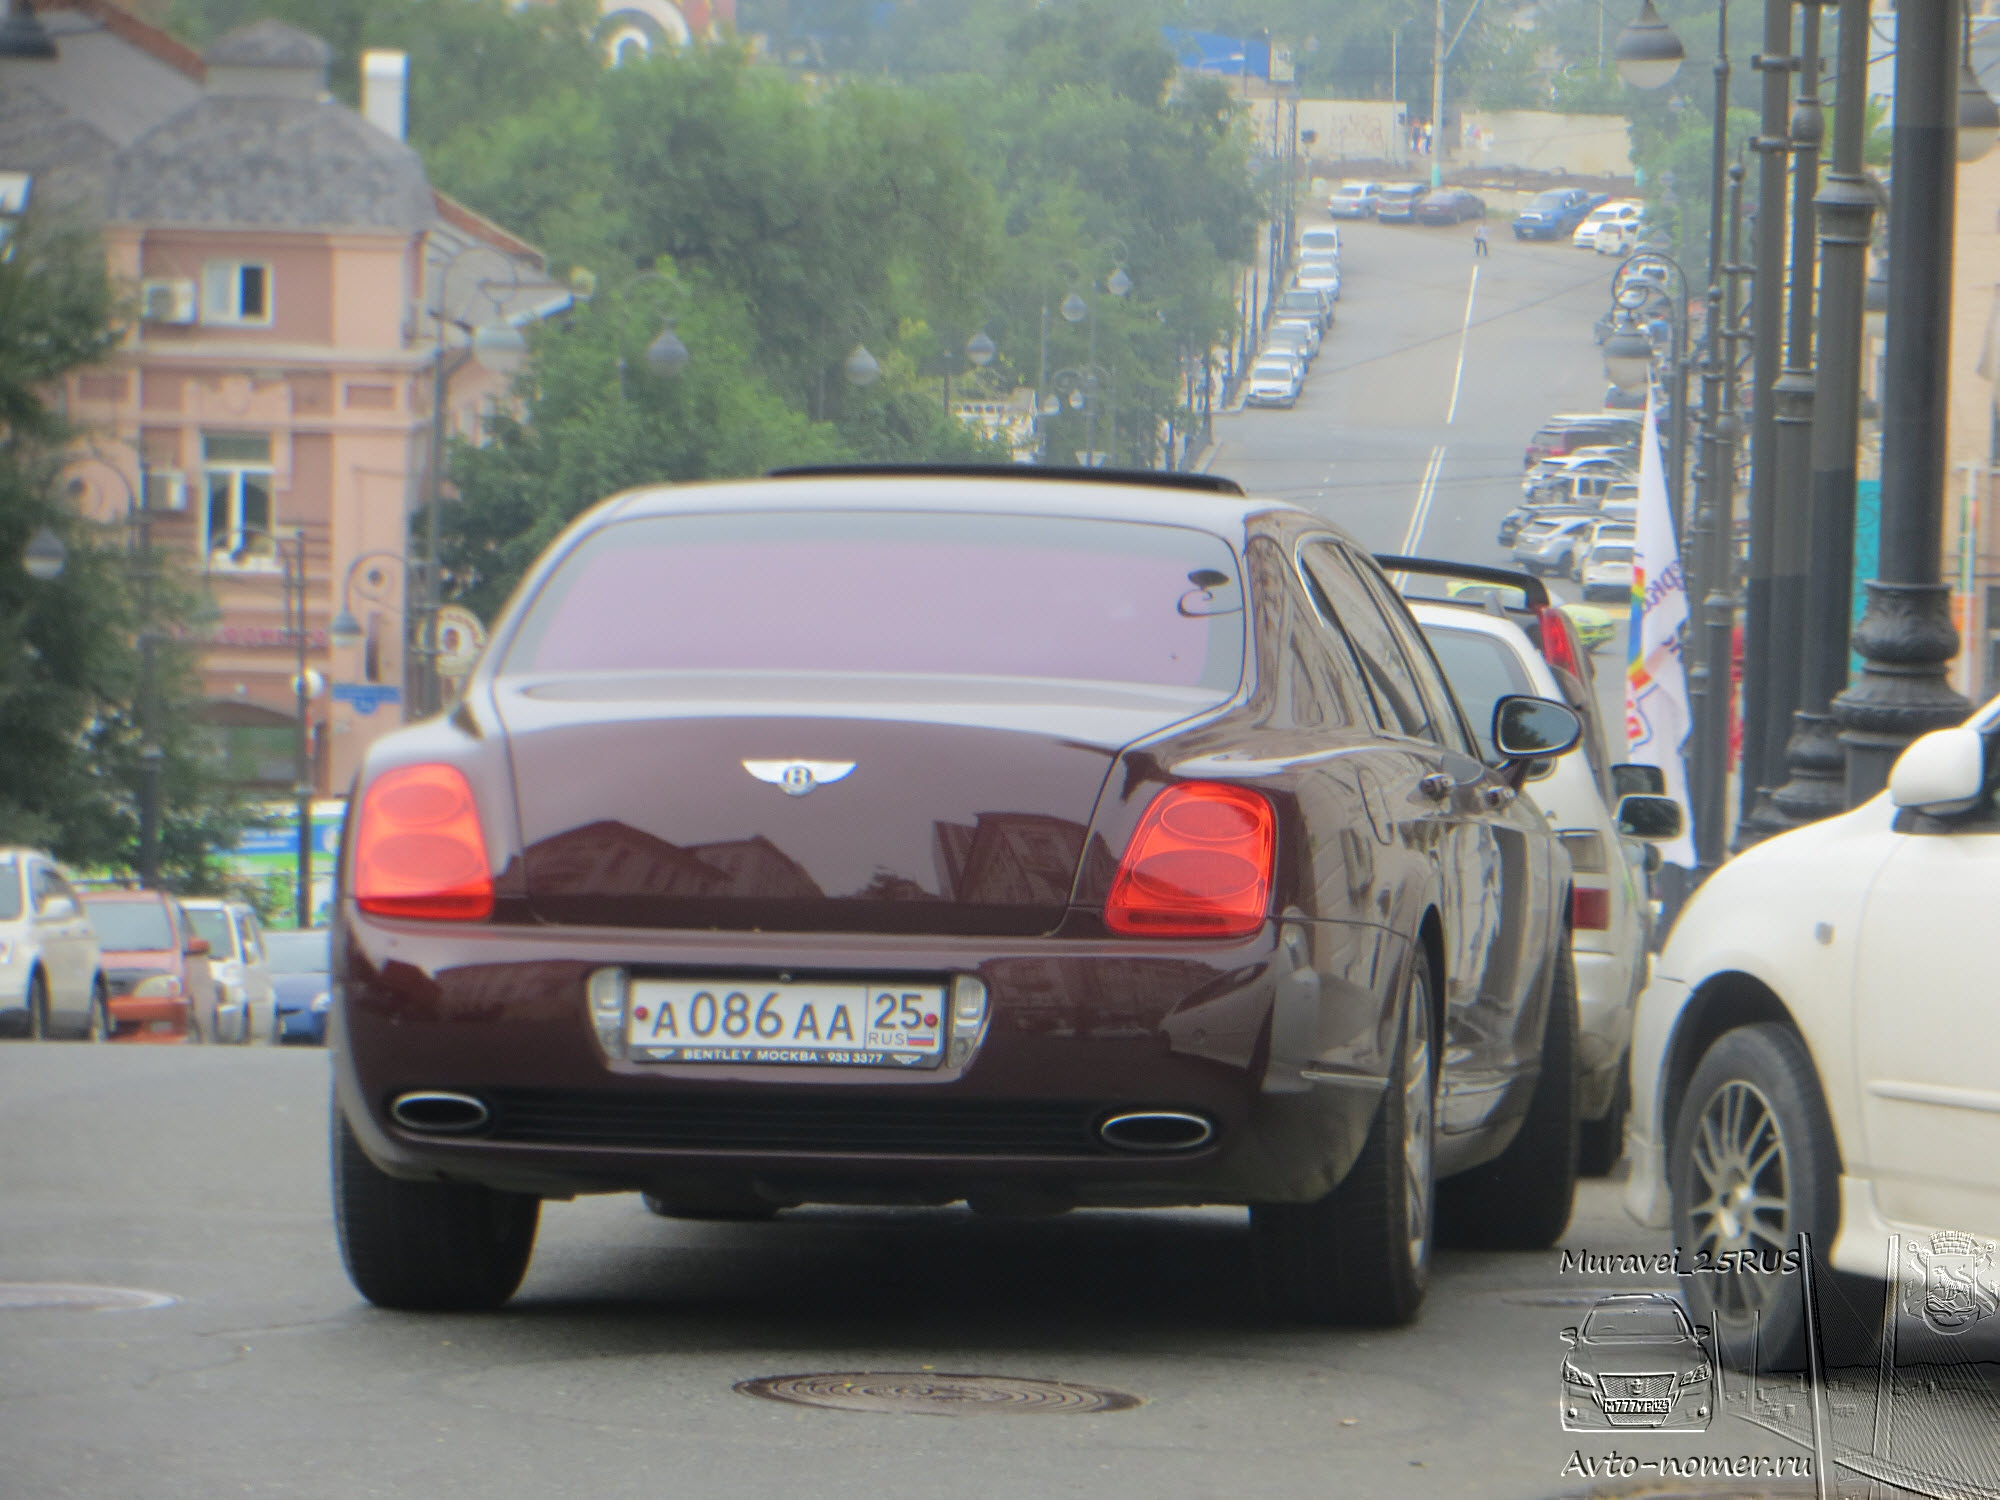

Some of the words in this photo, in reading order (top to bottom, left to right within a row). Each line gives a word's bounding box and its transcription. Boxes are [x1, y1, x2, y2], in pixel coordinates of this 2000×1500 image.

[874, 993, 924, 1030] 25
[868, 1031, 905, 1046] RUS
[682, 1048, 752, 1061] BENTLEY
[757, 1050, 819, 1062] МОСКВА
[827, 1051, 850, 1064] 933
[852, 1052, 885, 1064] 3377
